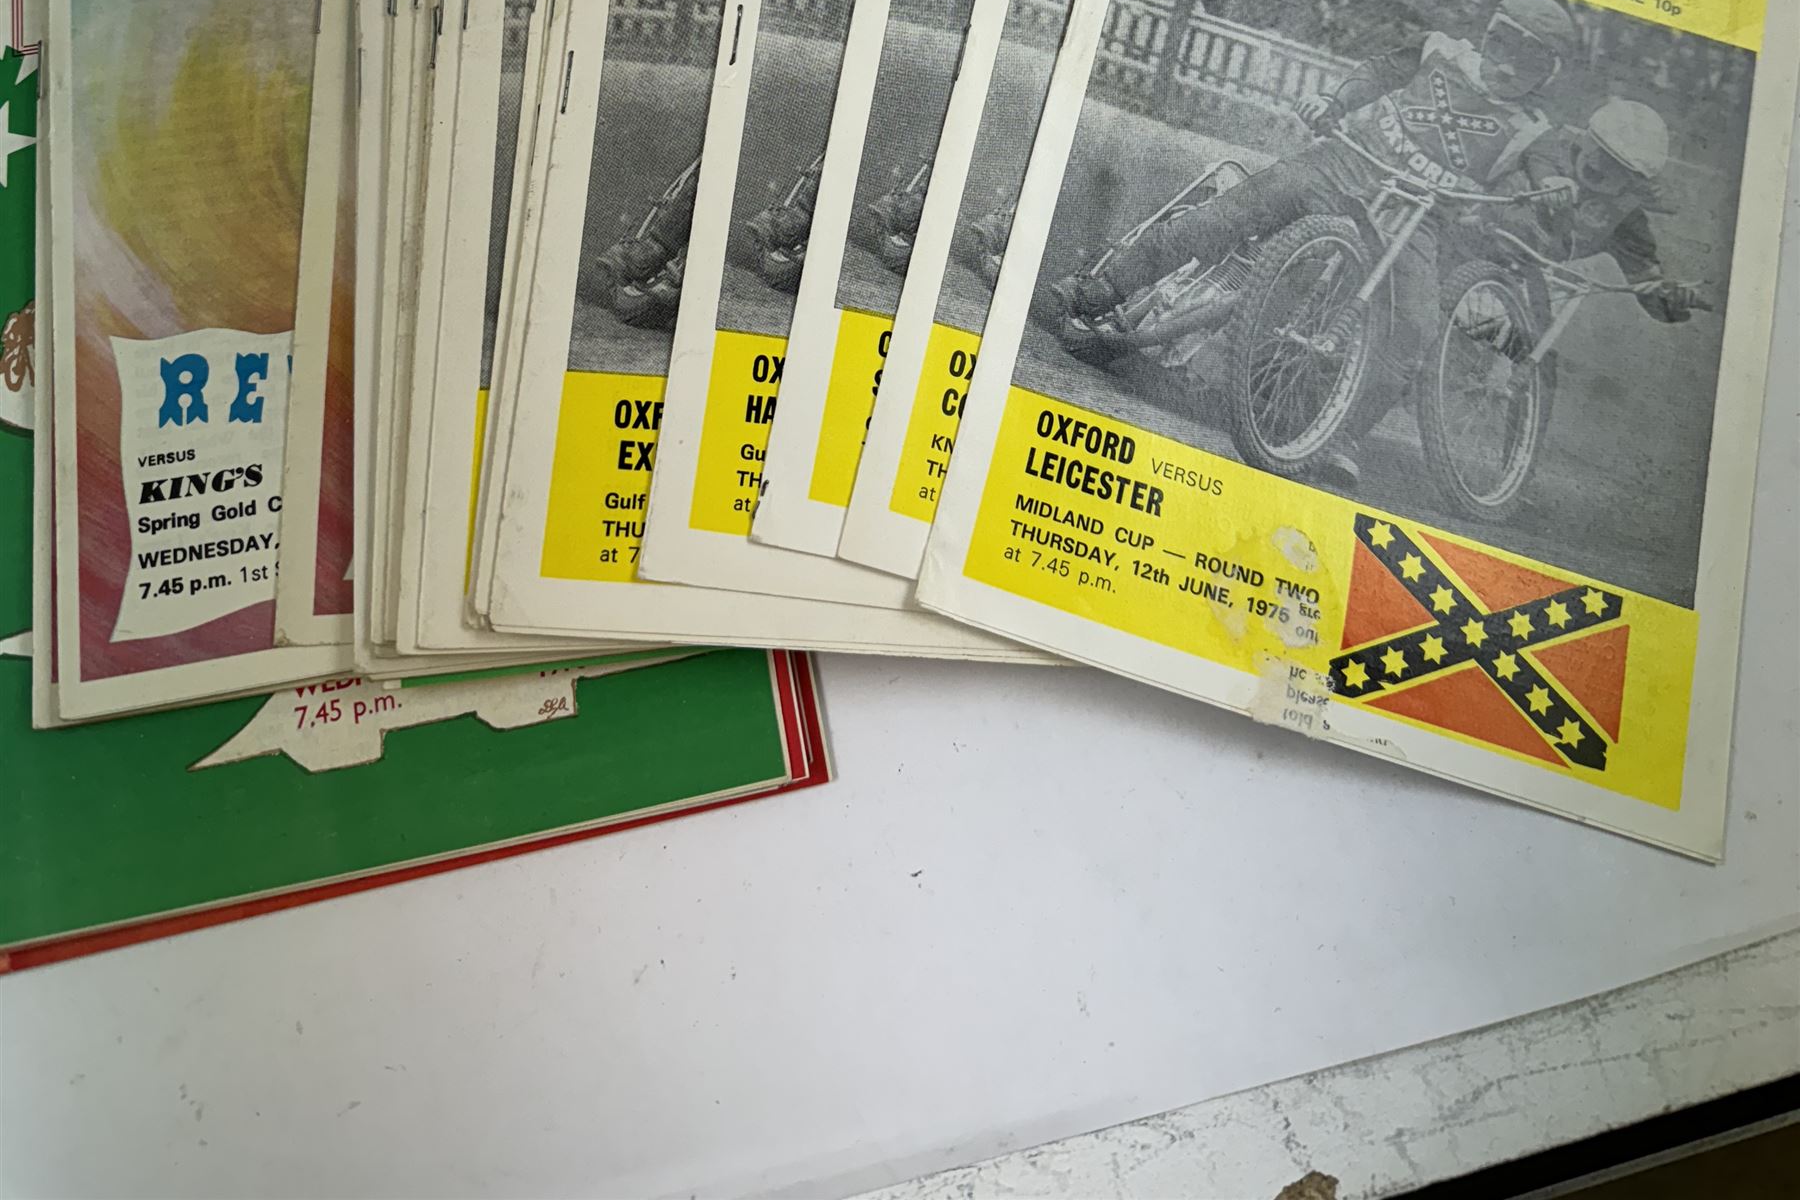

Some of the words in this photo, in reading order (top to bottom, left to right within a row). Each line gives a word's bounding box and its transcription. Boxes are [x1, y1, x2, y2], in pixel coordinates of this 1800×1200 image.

[752, 355, 785, 384] OX
[159, 353, 293, 428] RE
[138, 449, 196, 468] VERSUS
[618, 440, 655, 472] EX
[1036, 409, 1136, 466] OXFORD
[1150, 457, 1225, 497] VERSUS
[138, 464, 264, 505] KING'S
[918, 486, 937, 502] at
[1024, 446, 1165, 518] LEICESTER
[138, 512, 201, 536] Spring
[211, 500, 257, 523] Gold
[604, 492, 647, 510] Gulf
[733, 497, 751, 513] at
[602, 520, 646, 539] THU
[138, 533, 281, 569] WEDNESDAY,
[599, 547, 618, 563] at
[1014, 494, 1105, 536] MIDLAND
[1115, 526, 1155, 552] CUP
[1195, 552, 1265, 588] ROUND
[1275, 577, 1321, 605] TWO
[139, 577, 184, 600] 7.45
[190, 573, 232, 596] p.m.
[240, 565, 269, 584] 1st
[1003, 544, 1020, 563] at
[1030, 551, 1070, 579] 7.45
[1077, 567, 1117, 594] p.m.
[1009, 519, 1121, 572] THURSDAY,
[1131, 559, 1170, 587] 12th
[1178, 576, 1235, 609] JUNE,
[1247, 597, 1290, 624] 1975
[294, 699, 342, 729] 7.45
[354, 695, 402, 724] p.m.
